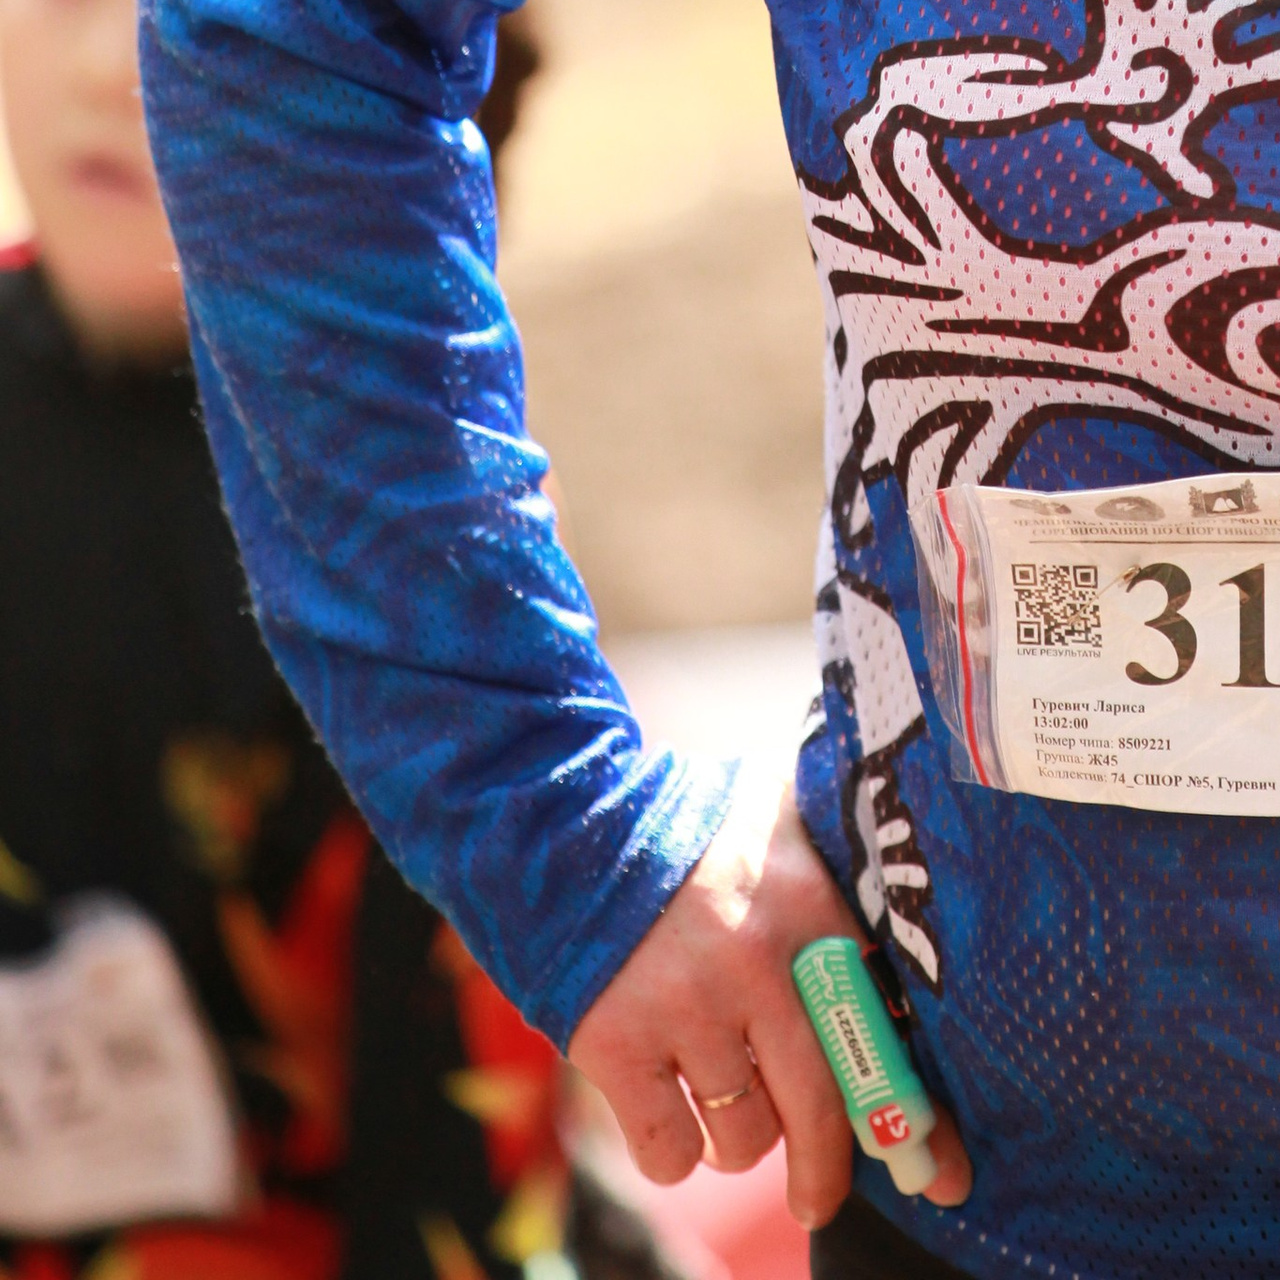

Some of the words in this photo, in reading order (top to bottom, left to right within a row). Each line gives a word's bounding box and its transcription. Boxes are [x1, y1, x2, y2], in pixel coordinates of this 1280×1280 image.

[1017, 648, 1037, 656] LIVE
[1040, 648, 1101, 658] РЕЗУЛЬТАТЫ
[1032, 697, 1090, 714] Гуревич
[1093, 700, 1146, 716] Лариса
[1033, 716, 1089, 730] 13:02:00
[1034, 733, 1076, 749] Номер
[1079, 739, 1114, 750] чипа:
[1118, 738, 1172, 751] 8509221
[1036, 749, 1085, 765] Группа:
[1087, 753, 1119, 767] Ж45
[1038, 766, 1108, 783] Коллектив:
[1218, 777, 1277, 793] Гуревич
[835, 1010, 873, 1078] 8509221
